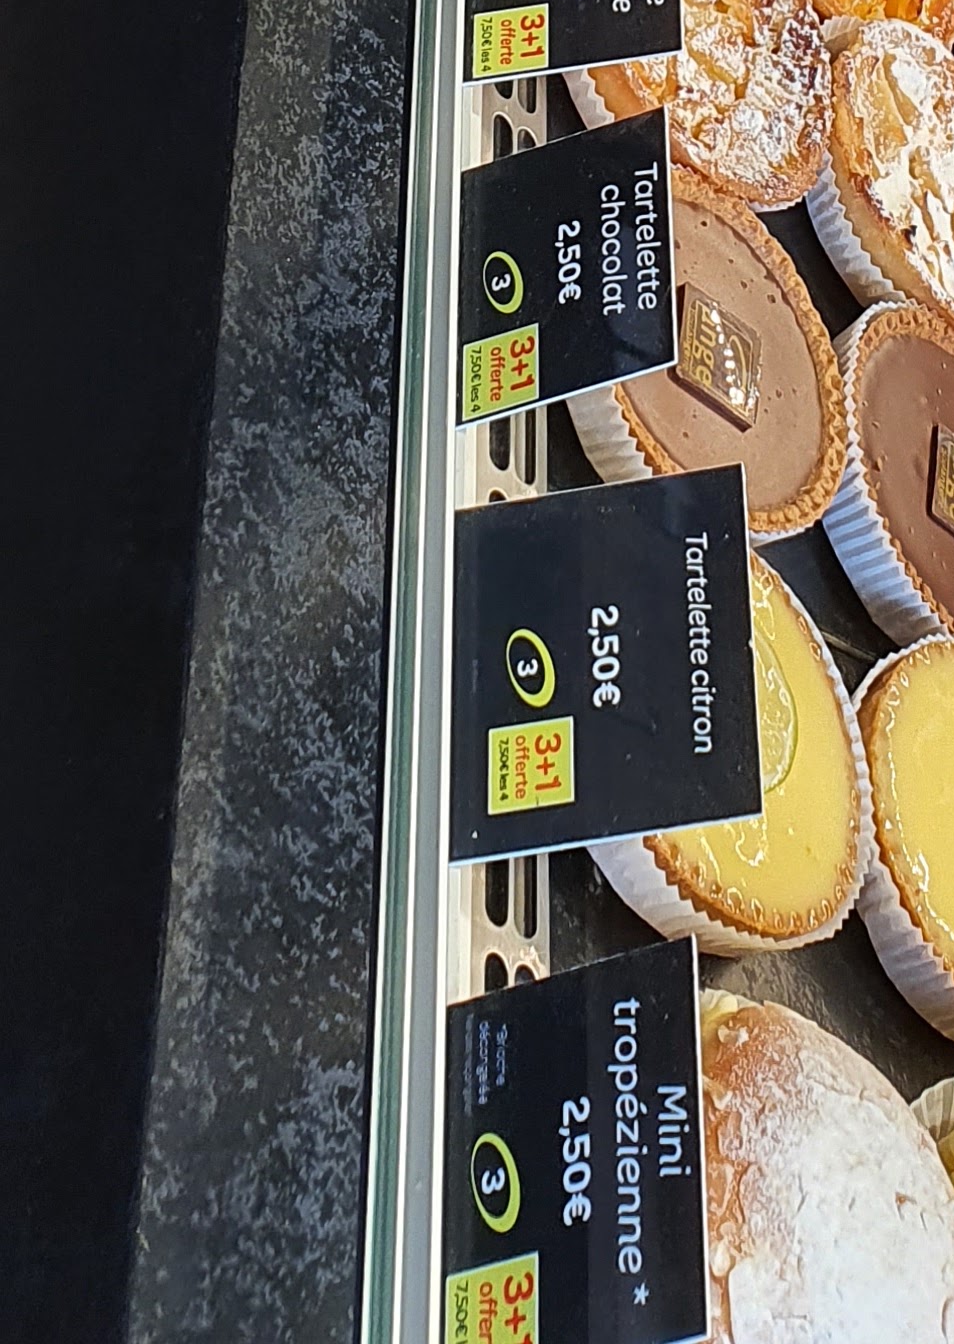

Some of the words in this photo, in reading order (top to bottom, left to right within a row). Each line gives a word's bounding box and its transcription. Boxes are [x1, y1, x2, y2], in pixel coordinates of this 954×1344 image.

[480, 17, 493, 47] 7,50€
[481, 47, 492, 64] les
[500, 19, 516, 65] offerte
[520, 14, 545, 58] 3+1
[554, 220, 581, 304] 2,50€
[600, 184, 628, 316] chocolat
[634, 162, 661, 310] Tartelette
[491, 273, 511, 292] 3
[470, 346, 482, 383] 7,50€
[490, 346, 506, 402] offerte
[509, 335, 535, 391] 3+1
[470, 383, 482, 402] les
[470, 404, 481, 413] 4
[684, 531, 712, 666] Tartelette
[516, 658, 539, 678] 3
[587, 604, 621, 708] 2,50€
[690, 670, 713, 754] citron
[498, 737, 509, 772] 7,50€
[499, 773, 510, 791] les
[515, 735, 530, 800] offerte
[534, 732, 562, 792] 3+1
[499, 793, 509, 801] 4
[607, 996, 648, 1274] tropézienne
[657, 1084, 692, 1178] Mini
[481, 1167, 506, 1196] 3
[558, 1096, 591, 1227] 2,50€
[454, 1279, 469, 1338] 7,50€
